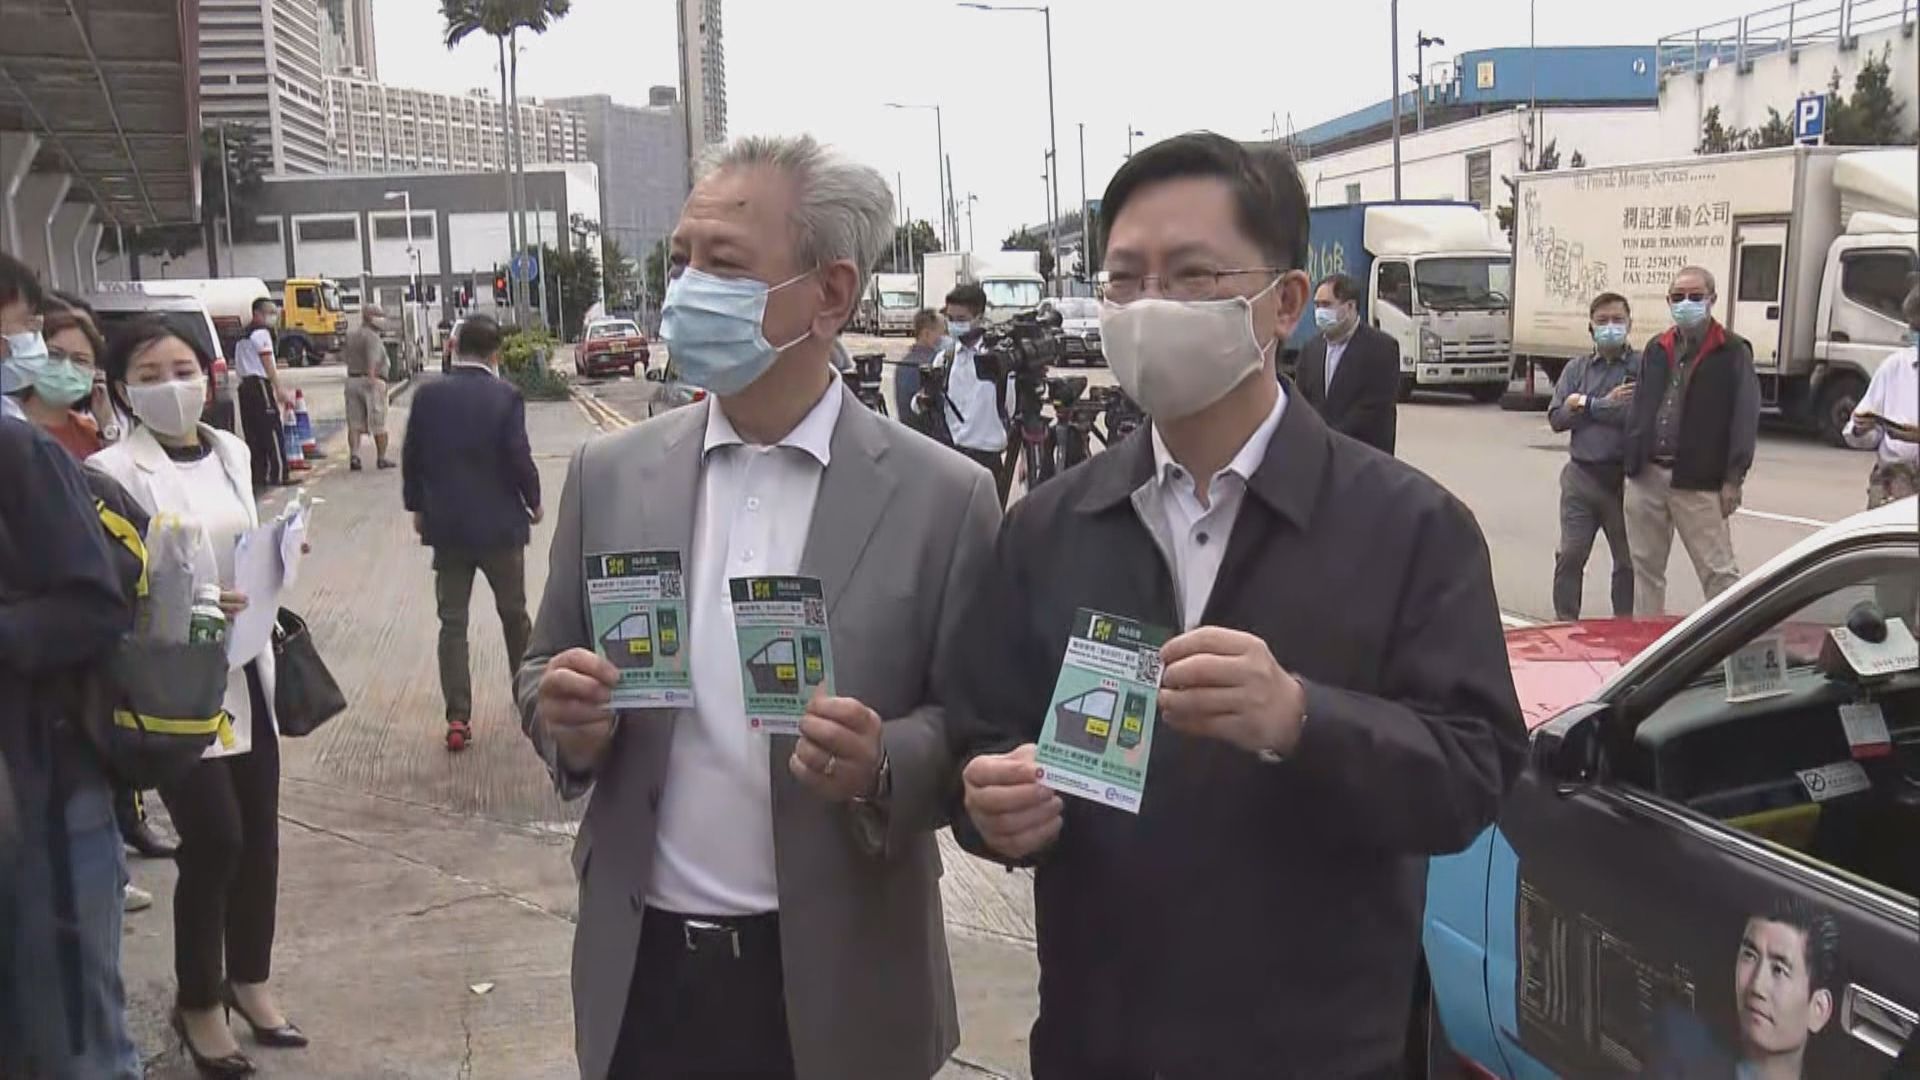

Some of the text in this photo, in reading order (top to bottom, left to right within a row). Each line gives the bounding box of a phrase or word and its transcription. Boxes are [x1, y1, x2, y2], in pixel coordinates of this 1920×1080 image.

[1800, 100, 1819, 134] P
[1659, 235, 1709, 248] TRANSPORT
[102, 282, 144, 295] TAXI
